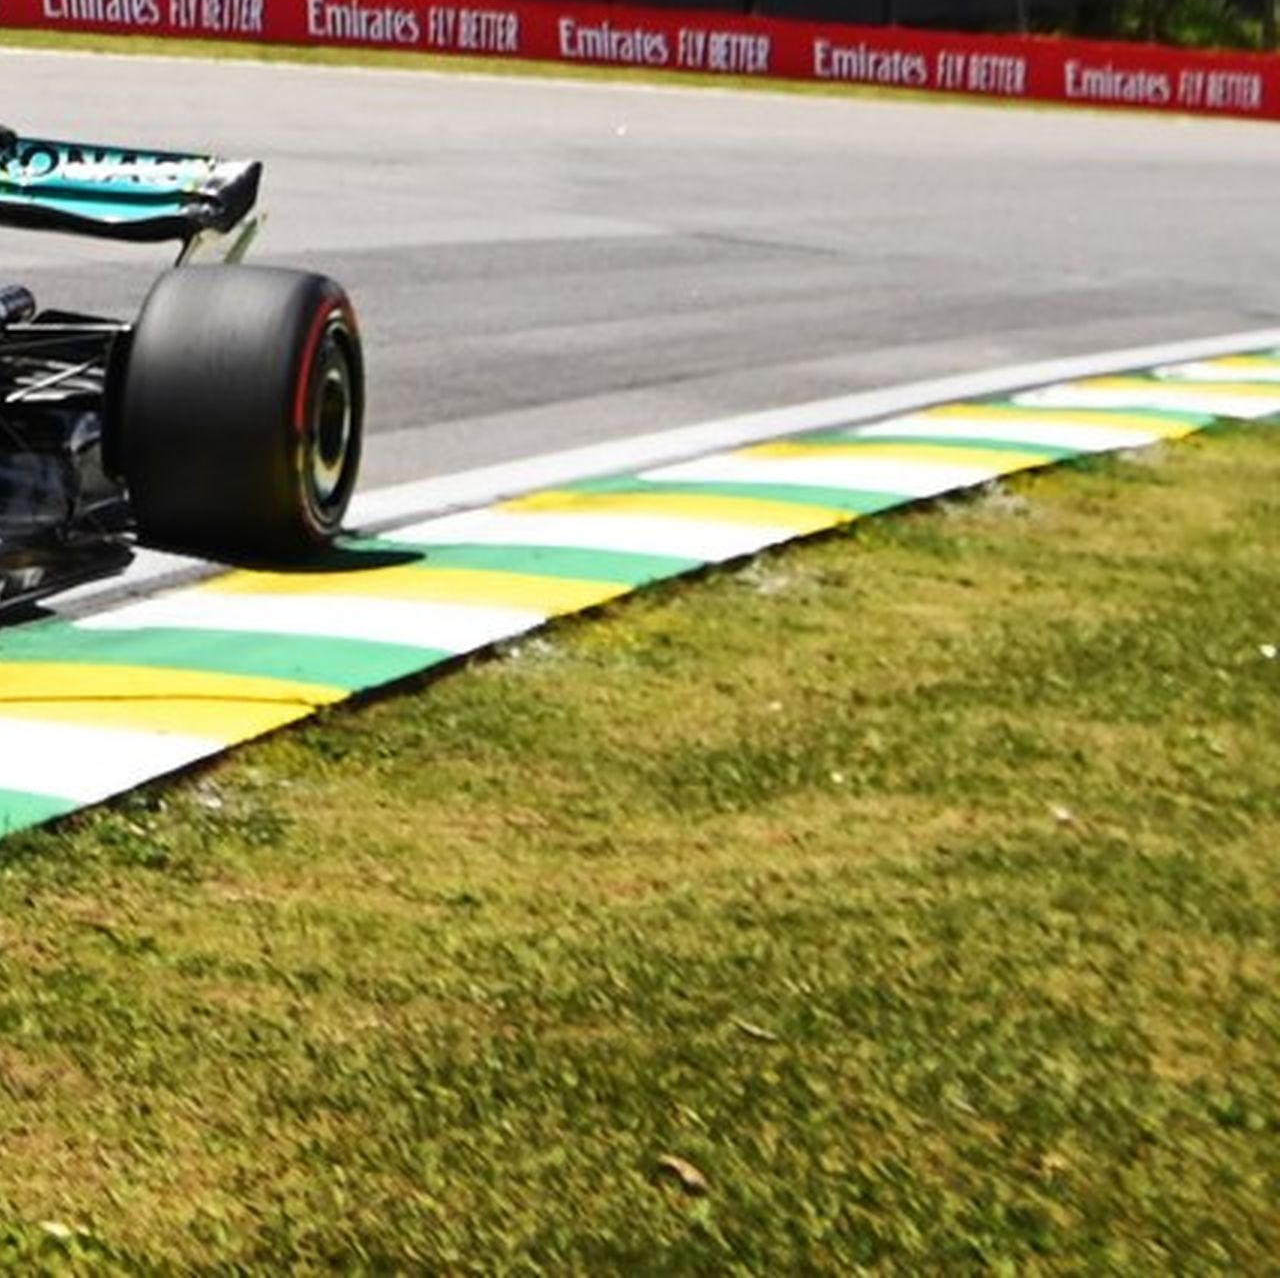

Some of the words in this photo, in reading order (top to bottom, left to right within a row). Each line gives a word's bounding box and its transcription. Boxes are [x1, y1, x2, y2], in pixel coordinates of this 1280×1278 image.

[428, 6, 455, 46] FLY
[458, 8, 518, 51] BETTER
[559, 18, 669, 63] Emirates
[678, 28, 705, 66] FLY
[708, 31, 770, 72] BETTER
[814, 39, 927, 84] Emirates
[937, 51, 963, 89] FLY
[968, 54, 1027, 94] BETTER
[1064, 60, 1171, 102] Emirates
[1179, 69, 1203, 106] FLY
[1205, 72, 1262, 108] BETTER
